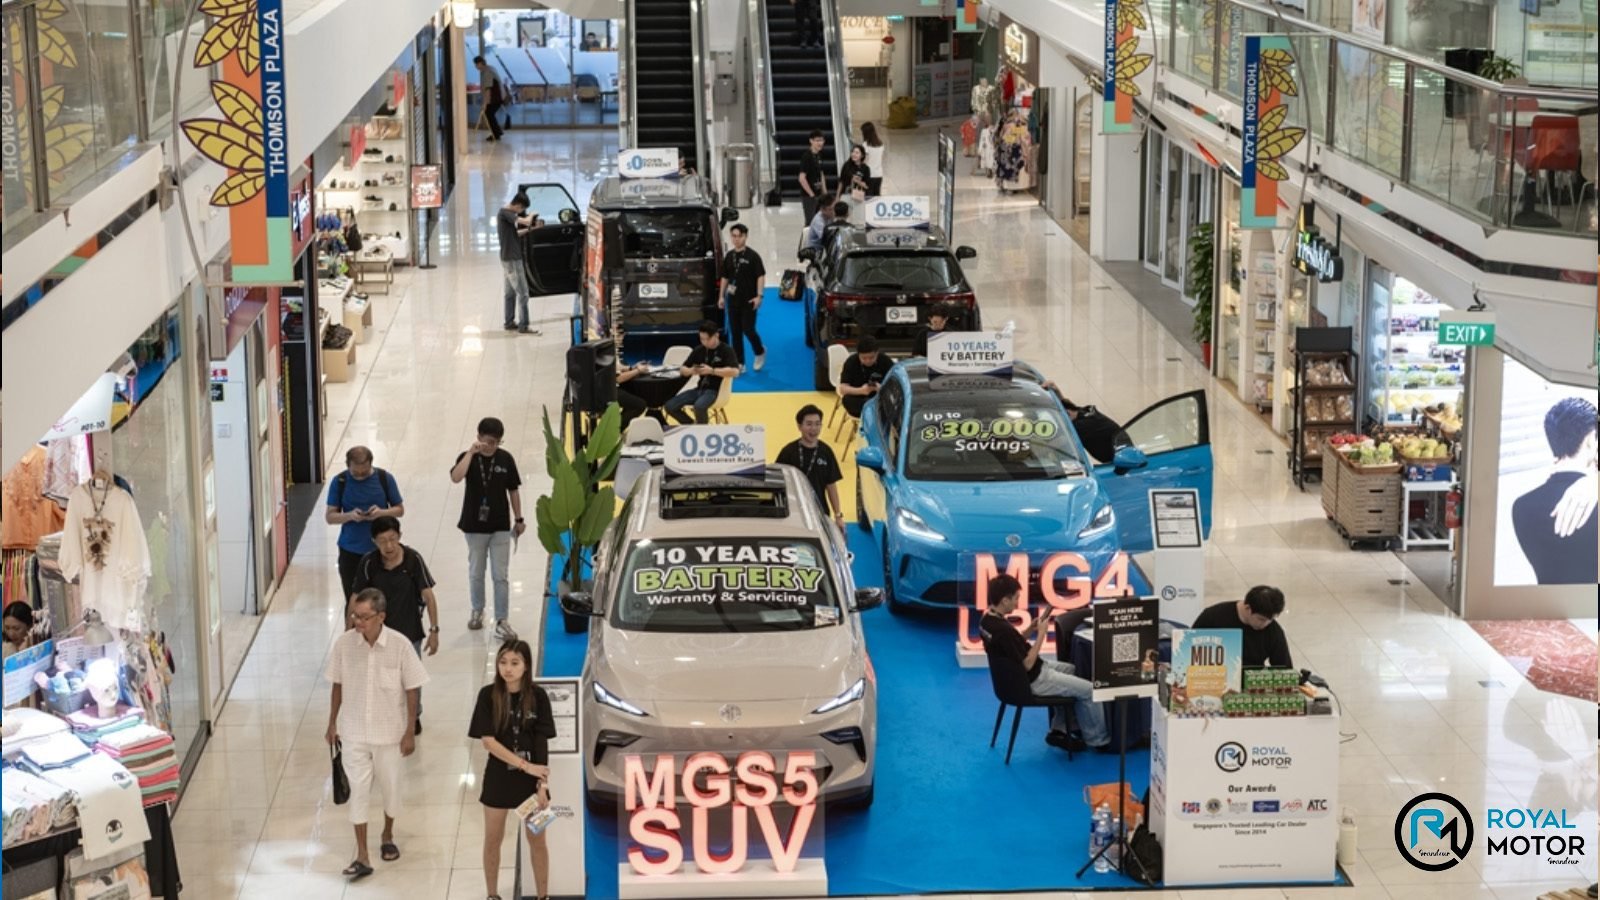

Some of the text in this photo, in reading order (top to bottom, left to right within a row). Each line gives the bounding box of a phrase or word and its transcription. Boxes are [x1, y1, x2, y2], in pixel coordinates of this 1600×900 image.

[1106, 3, 1116, 83] THOMSON PLAZA
[263, 9, 285, 178] THOMSON PLAZA
[1244, 62, 1258, 164] THOMSON PLAZA
[875, 201, 923, 217] 0.98%
[1446, 324, 1478, 342] EXIT
[947, 341, 997, 351] 10 YEARS
[941, 352, 1005, 361] EV BATTERY
[923, 412, 943, 421] Up
[922, 419, 1057, 441] $30,000
[680, 433, 755, 457] 0.98%
[954, 439, 1030, 453] Savings
[652, 546, 799, 565] 10 YEARS
[634, 564, 824, 595] BATTERY
[647, 592, 807, 605] Warranty & Servicing
[1108, 606, 1144, 616] SCAN HERE
[1127, 619, 1153, 627] PERFUME
[1190, 645, 1224, 666] MILO
[1251, 747, 1288, 755] ROYAL
[1251, 757, 1292, 766] MOTOR
[624, 751, 819, 811] MGS5
[1228, 784, 1276, 793] Our Awards
[1306, 799, 1328, 811] ATC
[627, 801, 817, 876] SUV
